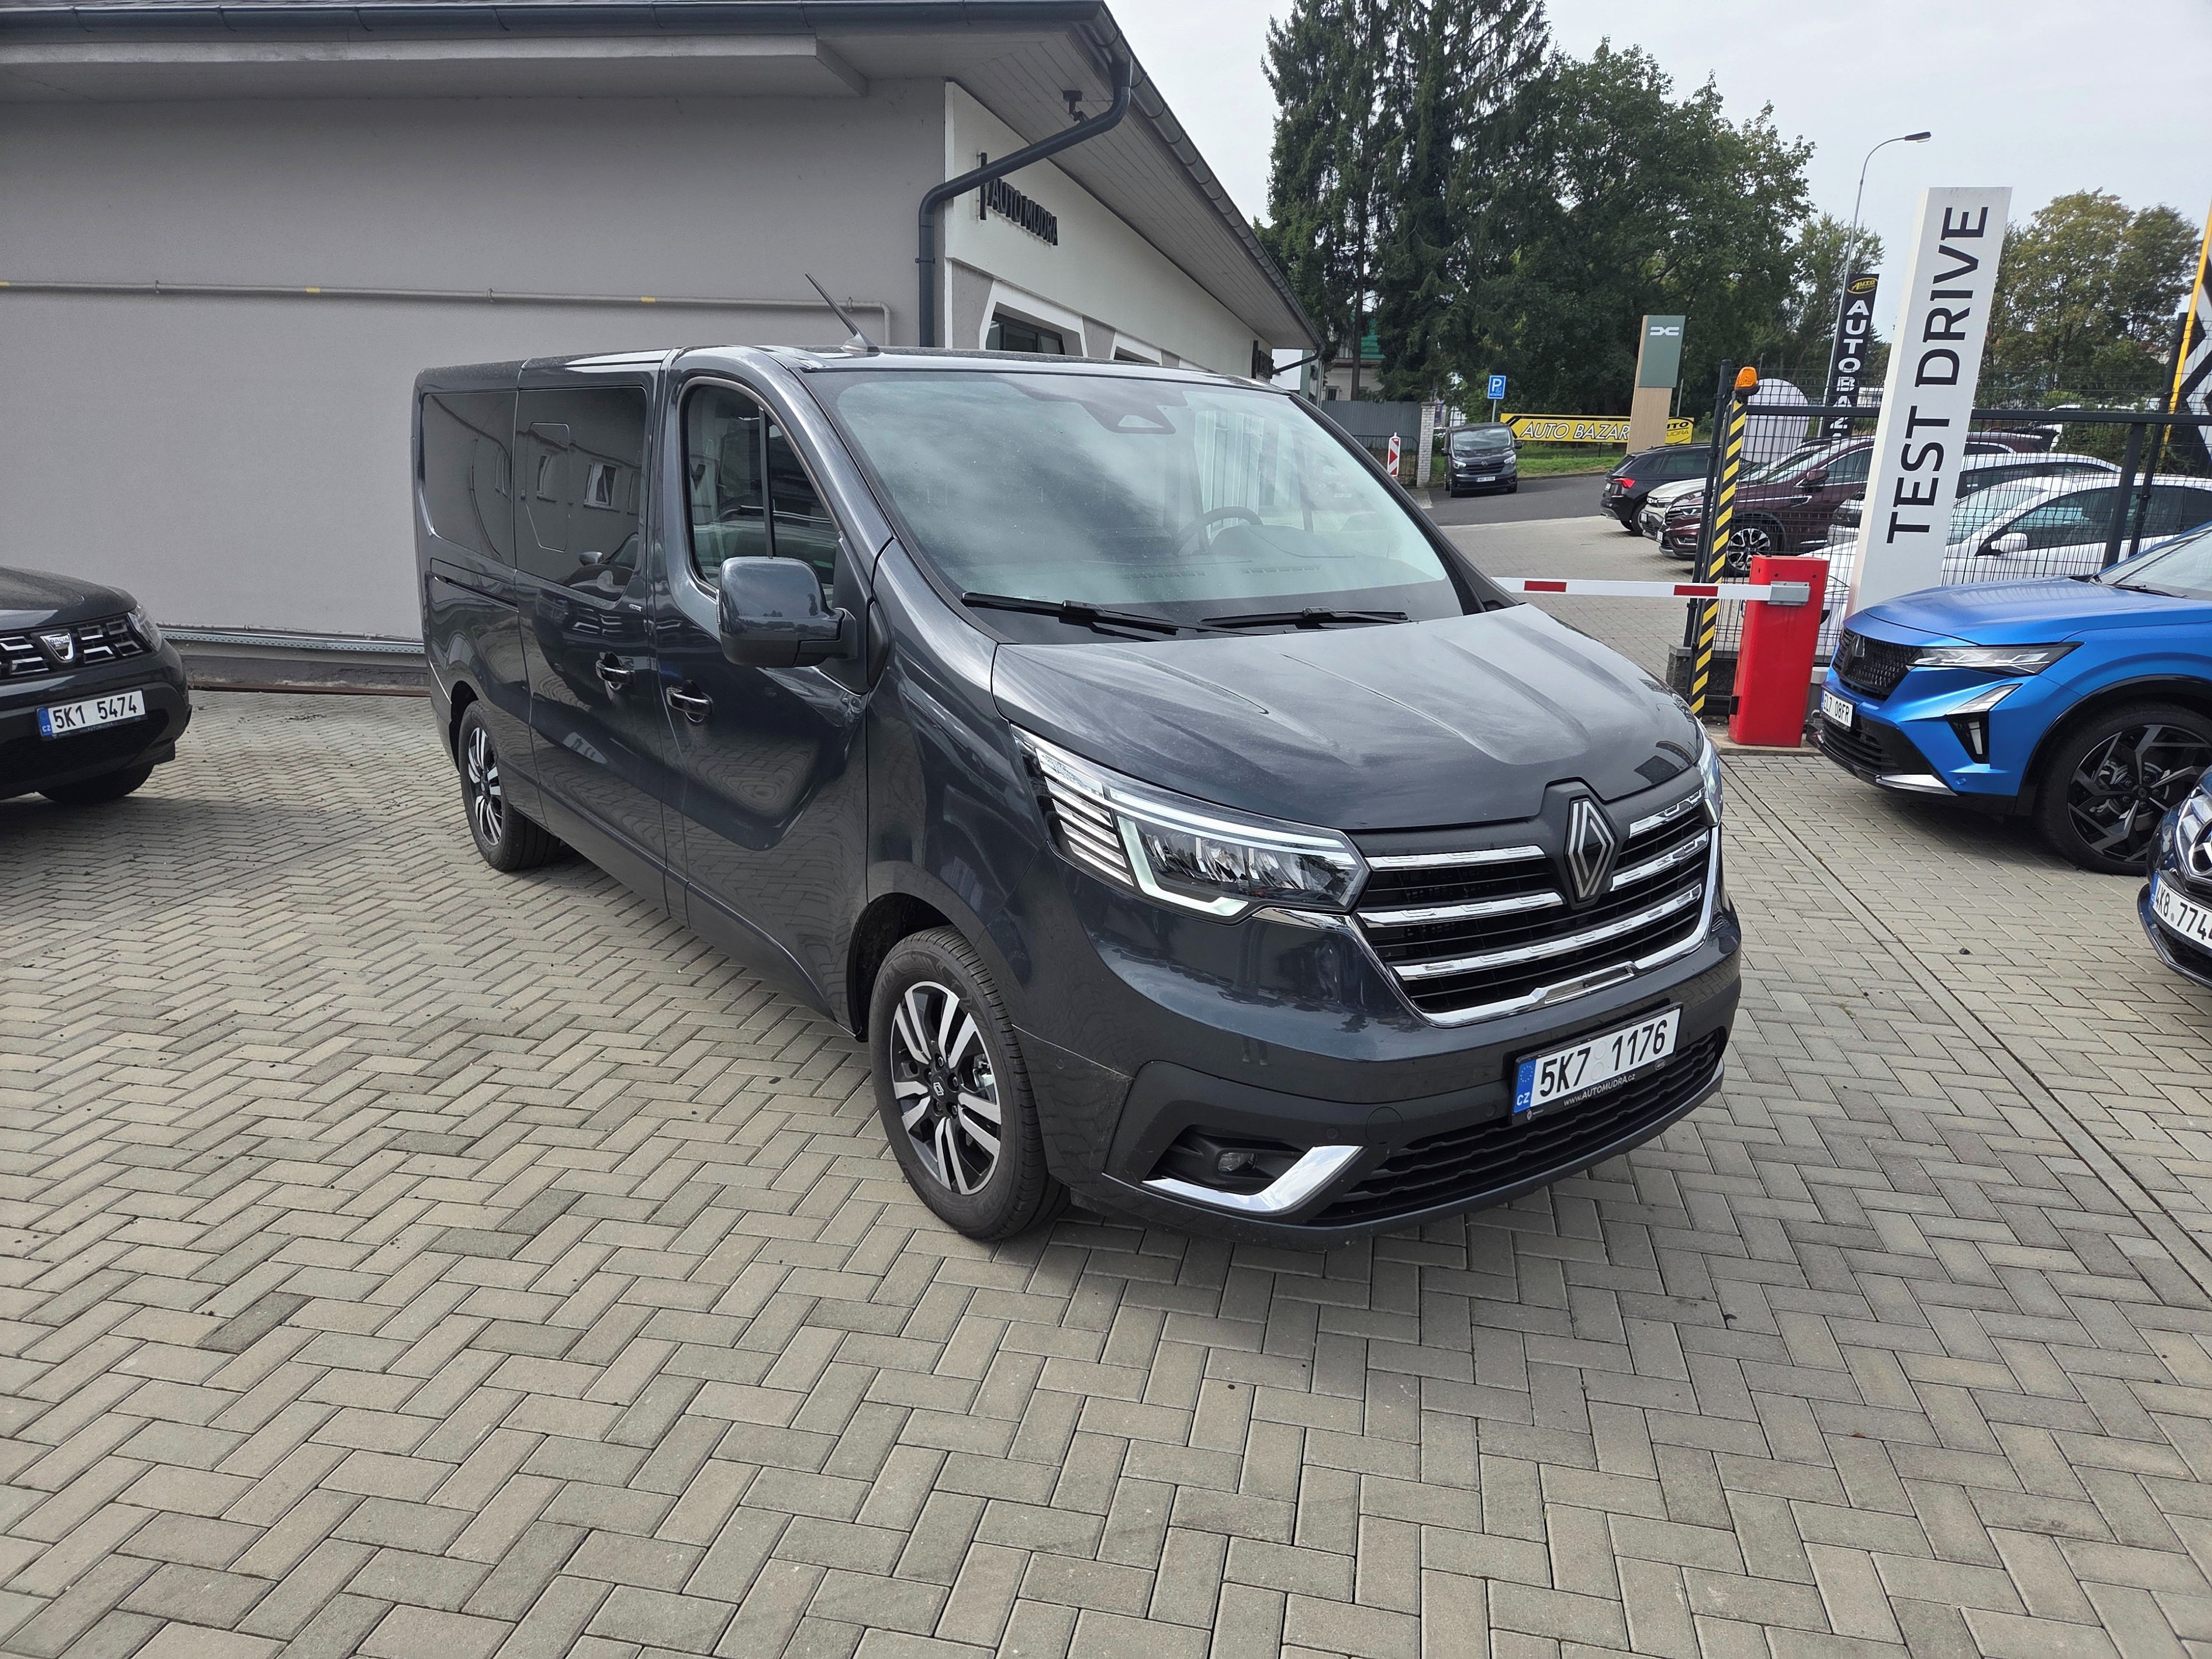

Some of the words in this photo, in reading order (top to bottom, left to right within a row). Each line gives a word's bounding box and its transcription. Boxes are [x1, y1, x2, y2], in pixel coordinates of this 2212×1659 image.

[1914, 207, 1989, 387] DRIVE
[1491, 378, 1503, 392] P
[1521, 421, 1569, 439] AUTO
[1573, 423, 1630, 440] BAZAR
[1886, 405, 1950, 544] TEST
[53, 705, 86, 729] 5K1
[97, 695, 137, 720] 5474
[1517, 1092, 1530, 1106] CZ
[1540, 1046, 1592, 1098] 5K7
[1611, 1019, 1668, 1071] 1176
